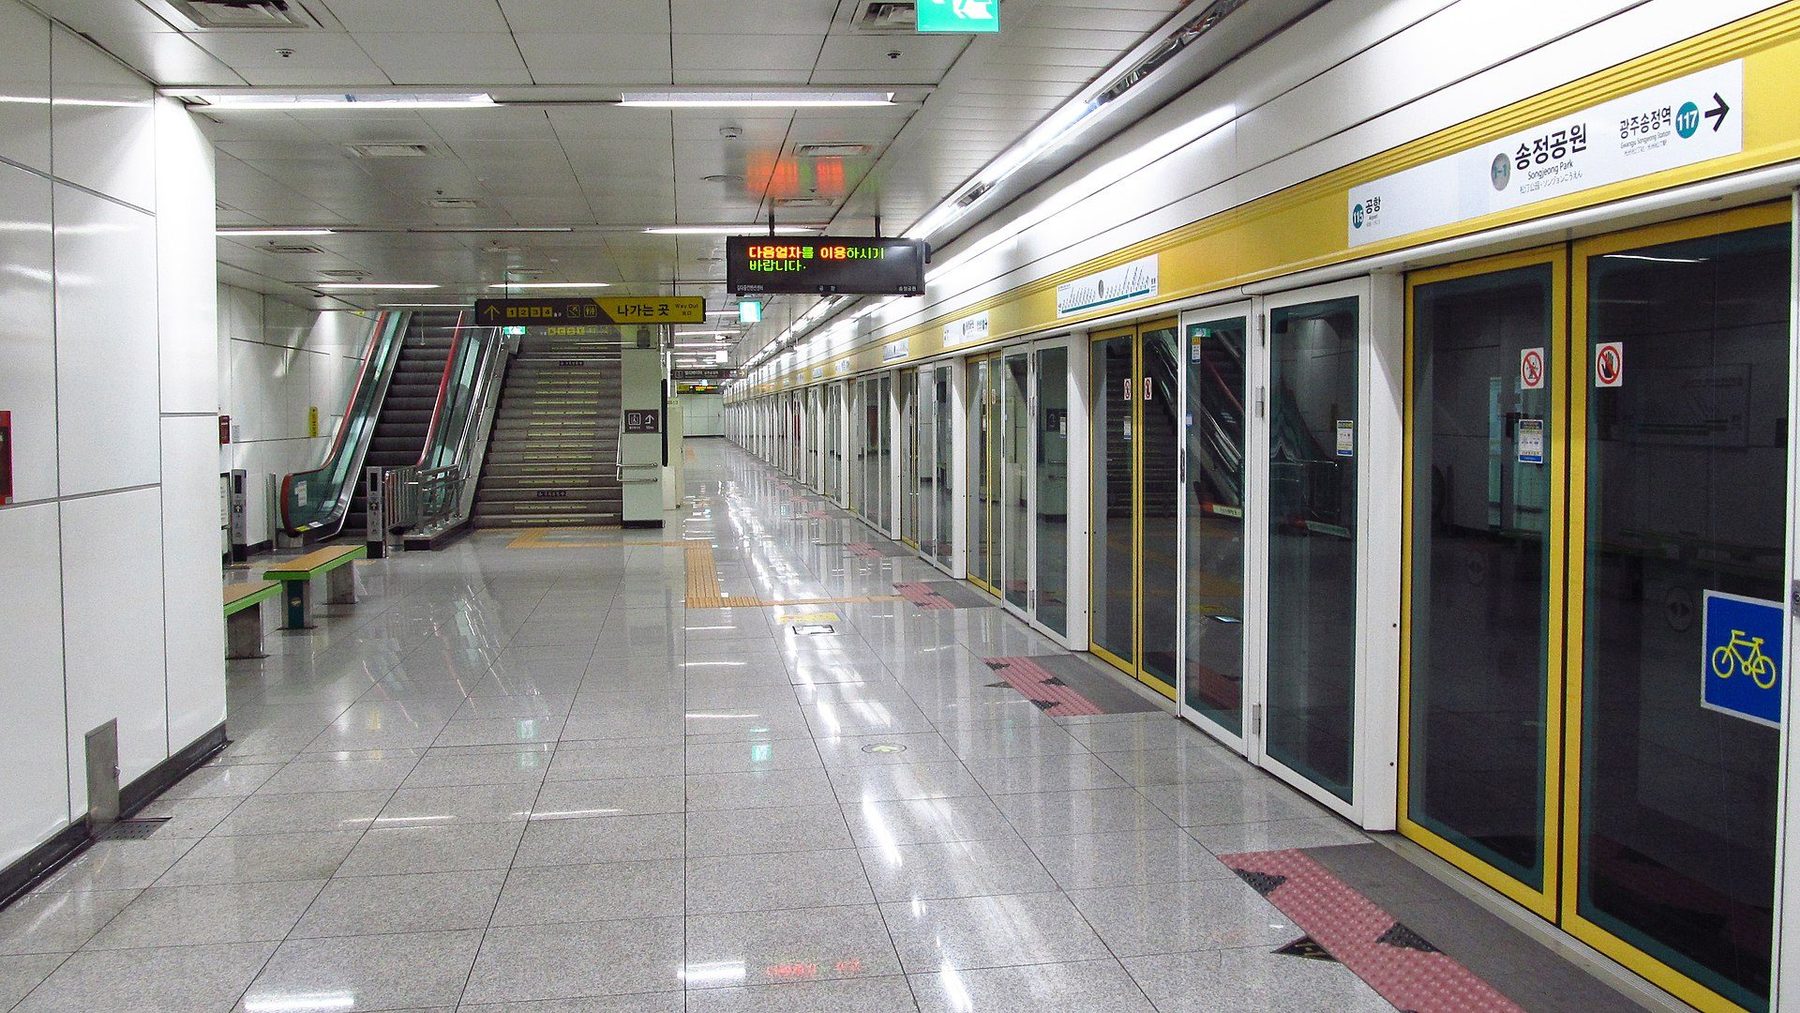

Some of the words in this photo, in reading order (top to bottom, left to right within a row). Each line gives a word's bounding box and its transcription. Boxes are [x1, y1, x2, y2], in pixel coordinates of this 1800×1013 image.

[1619, 105, 1671, 139] 광주송정역
[1677, 109, 1698, 131] 117
[1514, 122, 1587, 171] 송정공원
[1527, 165, 1559, 180] Songjeong
[1559, 159, 1574, 171] Park
[1365, 196, 1381, 214] 공항
[1353, 209, 1364, 224] 115
[748, 246, 814, 259] 다음열차를
[820, 246, 885, 260] 이용하시기
[617, 303, 654, 317] 나가는
[658, 303, 670, 316] 곳
